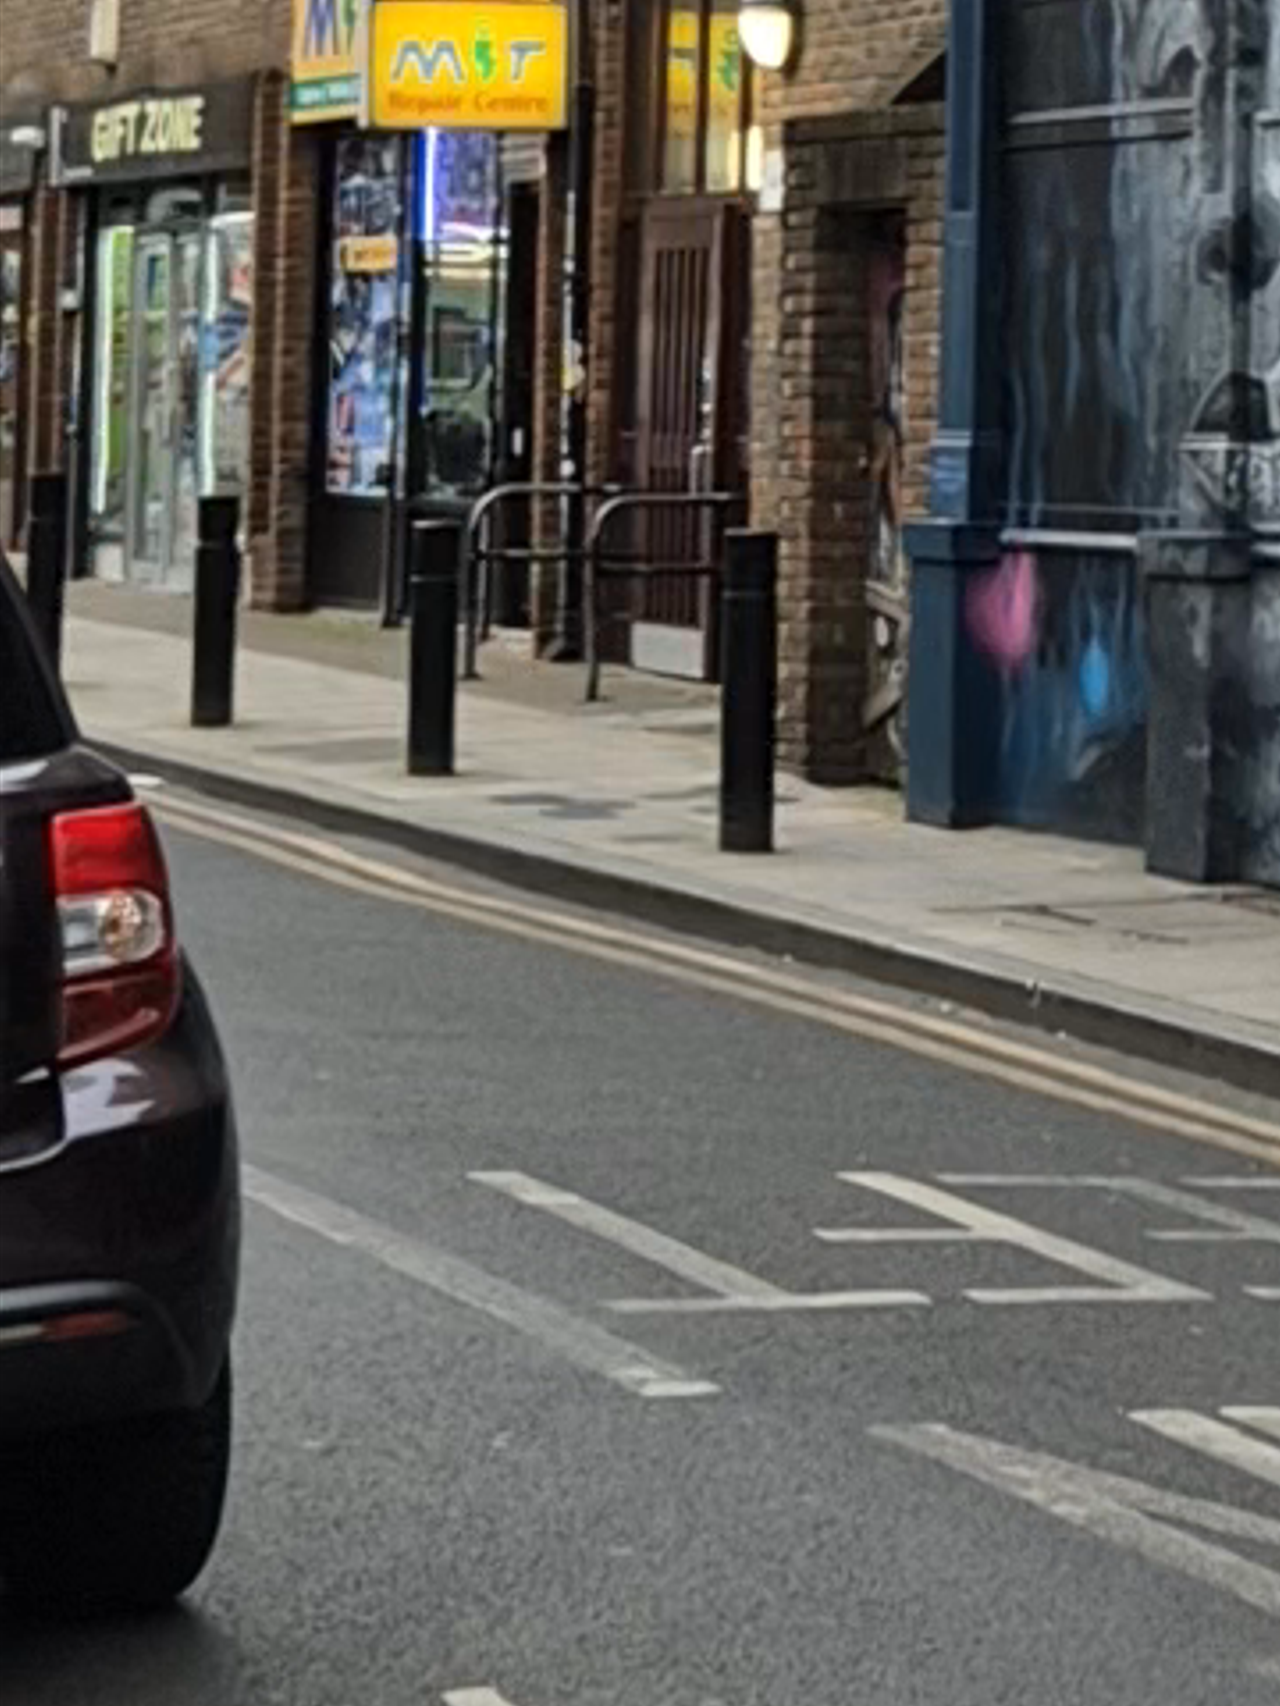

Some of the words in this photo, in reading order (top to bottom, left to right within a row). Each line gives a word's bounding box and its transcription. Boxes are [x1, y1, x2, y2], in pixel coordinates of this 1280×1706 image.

[388, 92, 463, 116] Repair
[474, 91, 549, 114] Centre
[91, 100, 143, 162] GIFT
[140, 96, 205, 153] ZONE
